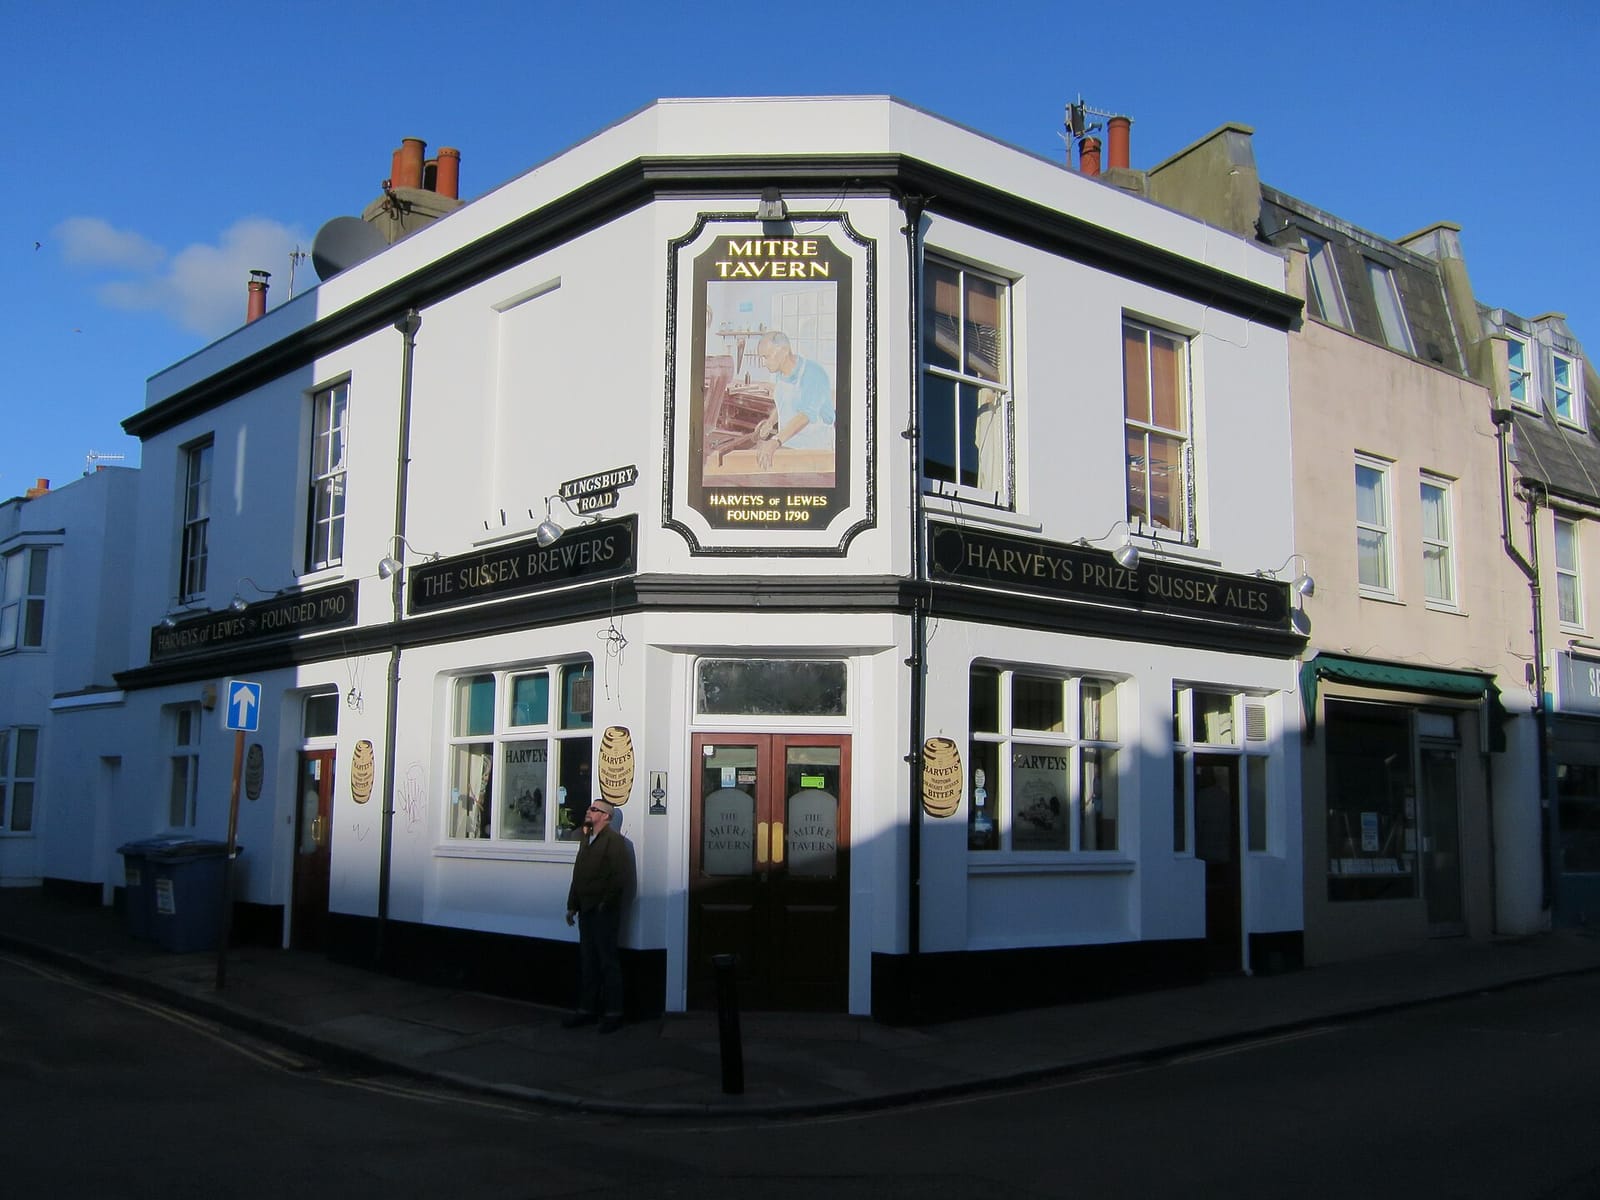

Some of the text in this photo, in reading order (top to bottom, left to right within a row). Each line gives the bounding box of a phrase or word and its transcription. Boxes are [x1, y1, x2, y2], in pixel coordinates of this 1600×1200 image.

[728, 240, 818, 256] MITRE
[715, 261, 829, 278] TAVERN
[564, 468, 633, 498] KINGSBURY
[581, 492, 613, 511] ROAD
[710, 495, 764, 506] HARVEYS
[787, 495, 828, 506] LEWES
[727, 510, 809, 521] FOUNDED 1790
[423, 536, 615, 597] THE SUSSEX BREWERS
[967, 543, 1268, 612] HARVEYS PRIZE SUSSEX ALES
[158, 627, 199, 650] HARVEYS
[212, 617, 246, 641] LEWES
[261, 602, 316, 631] FOUNDED
[319, 595, 346, 619] 1790
[505, 748, 548, 764] HARVEYS
[1018, 755, 1067, 770] ARVEYS
[928, 789, 954, 798] BITTER
[709, 825, 749, 838] MITRE
[793, 826, 834, 838] MITRE
[707, 840, 750, 850] TAVERN
[791, 841, 835, 851] TAVERN
